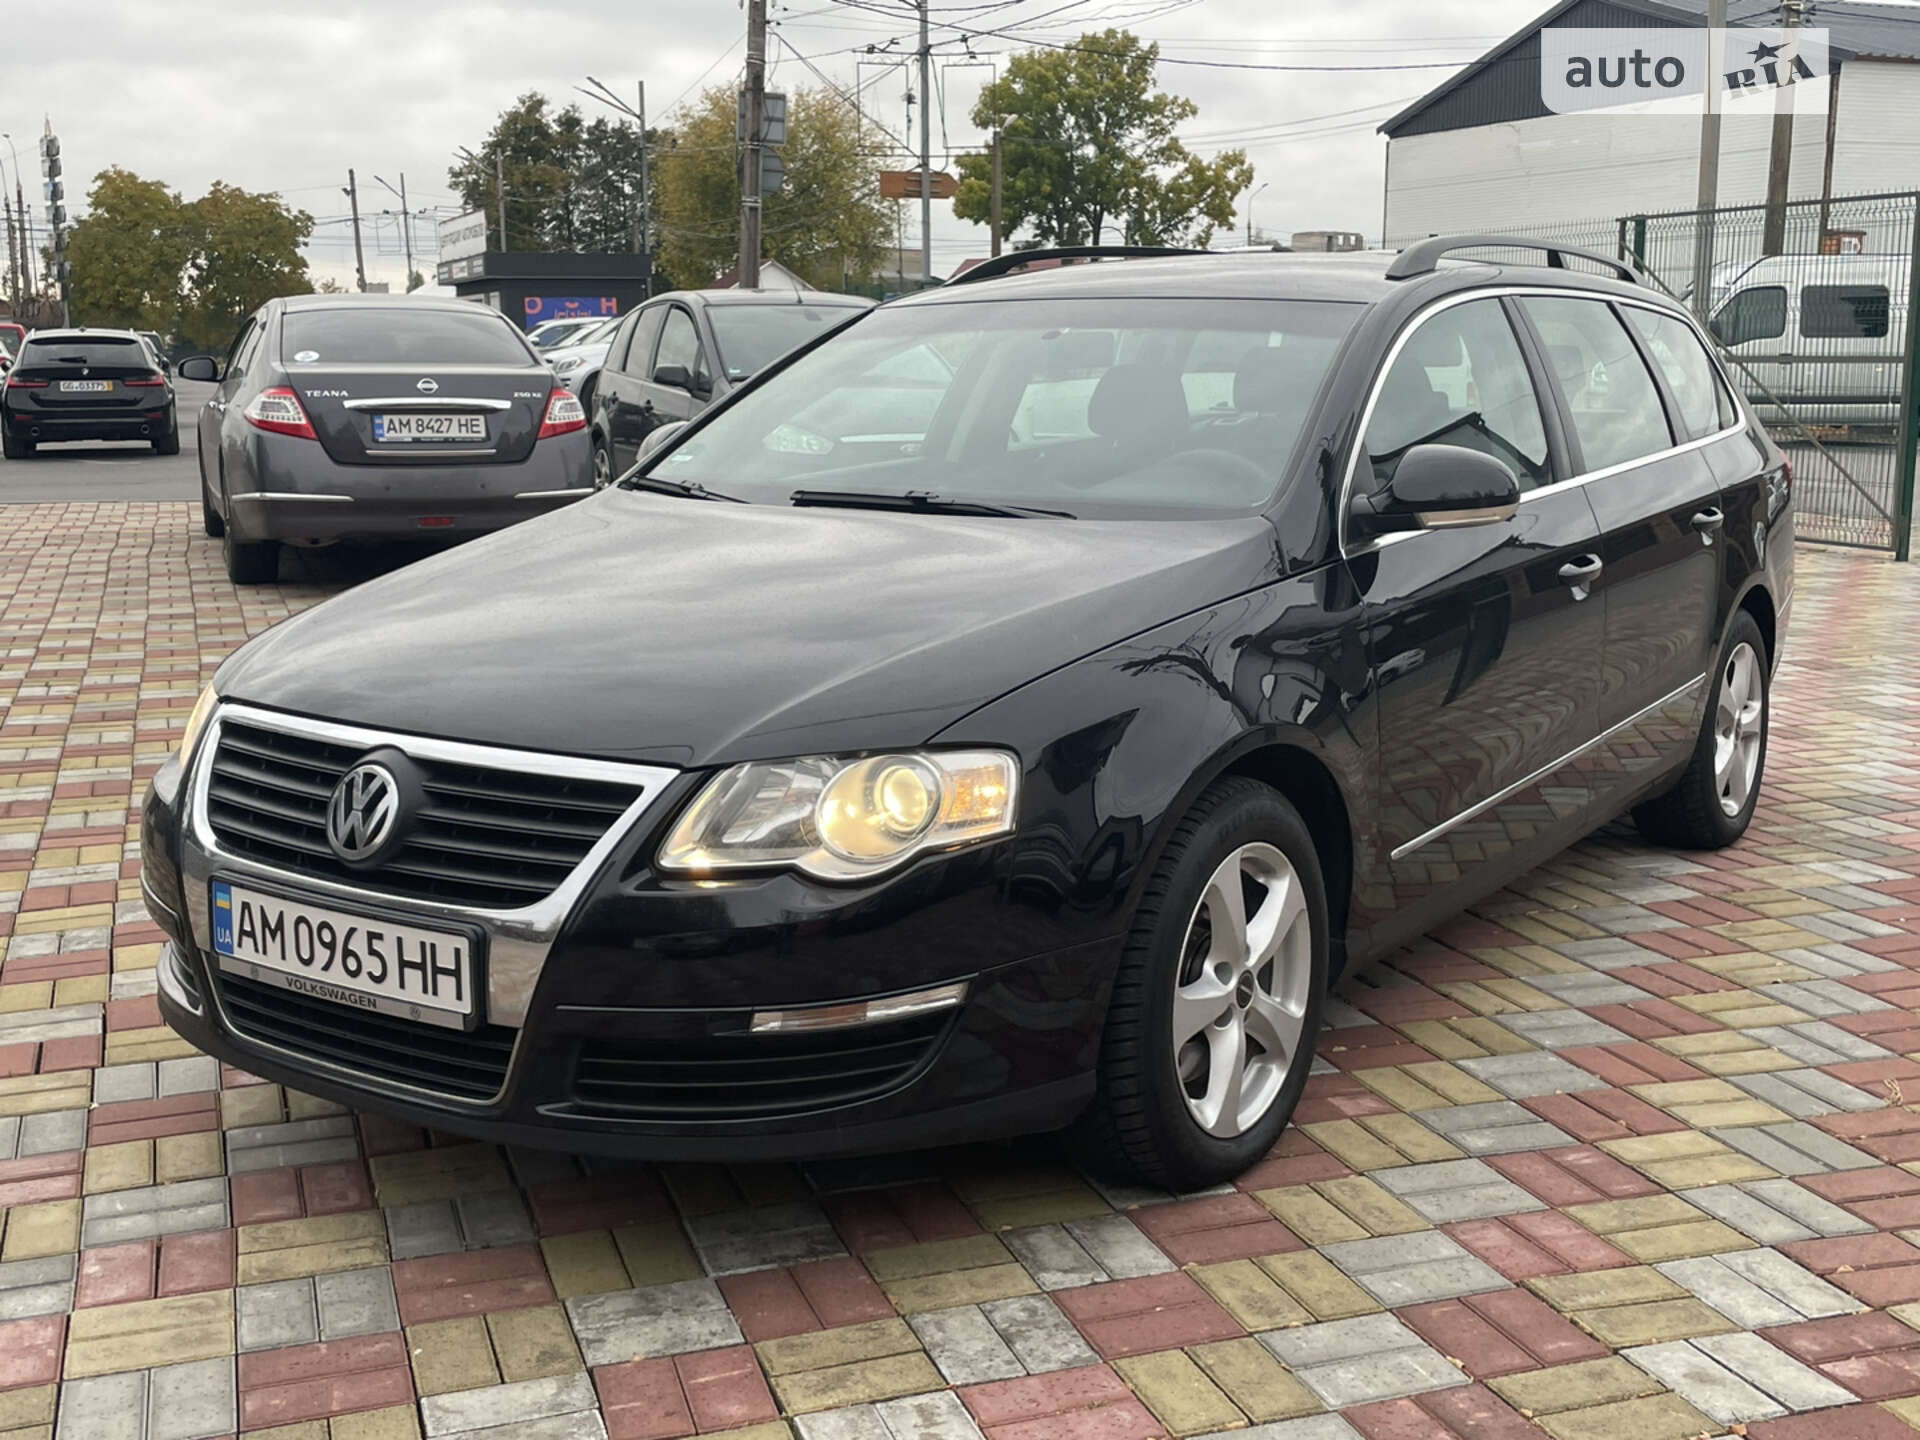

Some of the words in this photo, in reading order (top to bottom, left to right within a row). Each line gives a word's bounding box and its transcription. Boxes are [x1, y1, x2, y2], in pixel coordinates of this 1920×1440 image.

[386, 418, 412, 434] AM
[416, 418, 453, 434] 8427
[458, 418, 481, 434] HE
[217, 926, 232, 945] UA
[285, 975, 378, 1010] VOLKSWAGEN
